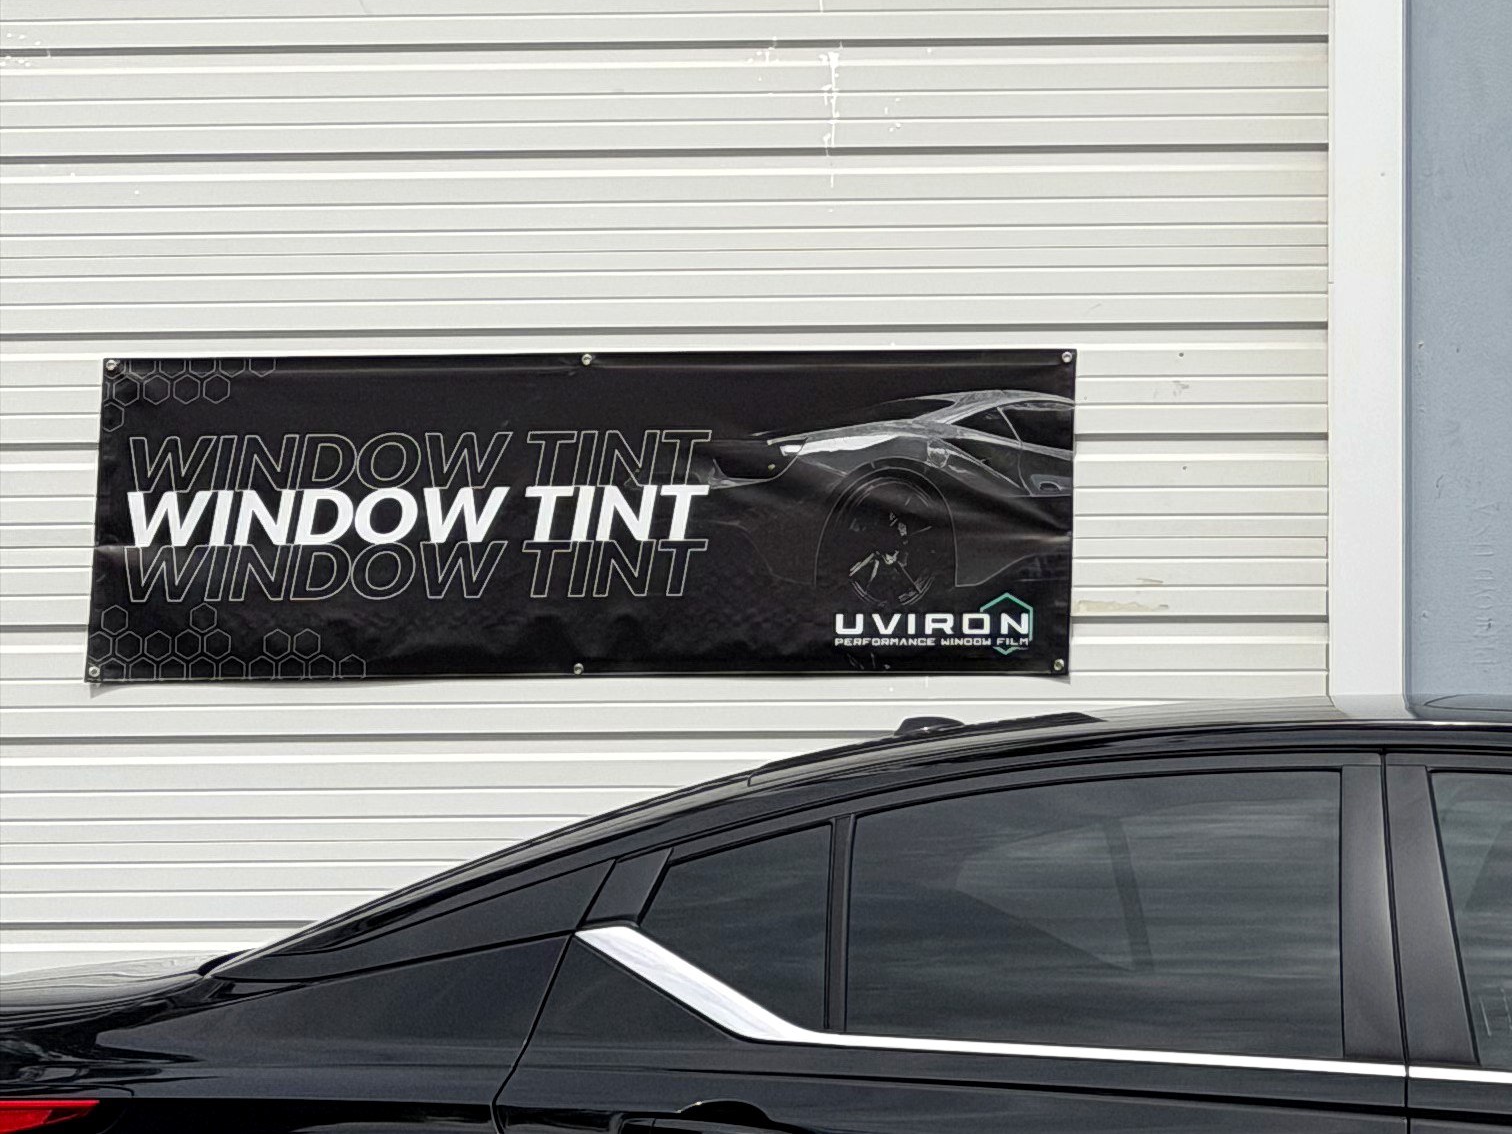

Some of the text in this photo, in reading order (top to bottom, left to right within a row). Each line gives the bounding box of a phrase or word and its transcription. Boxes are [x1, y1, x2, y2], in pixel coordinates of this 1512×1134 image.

[129, 430, 712, 493] WINDOW TINT
[127, 484, 709, 547] WINDOW TINT
[125, 539, 708, 602] WINDOW TINT
[834, 637, 1029, 646] PERFORMANCE WINDOW FILM
[835, 613, 1029, 635] UVIRON
